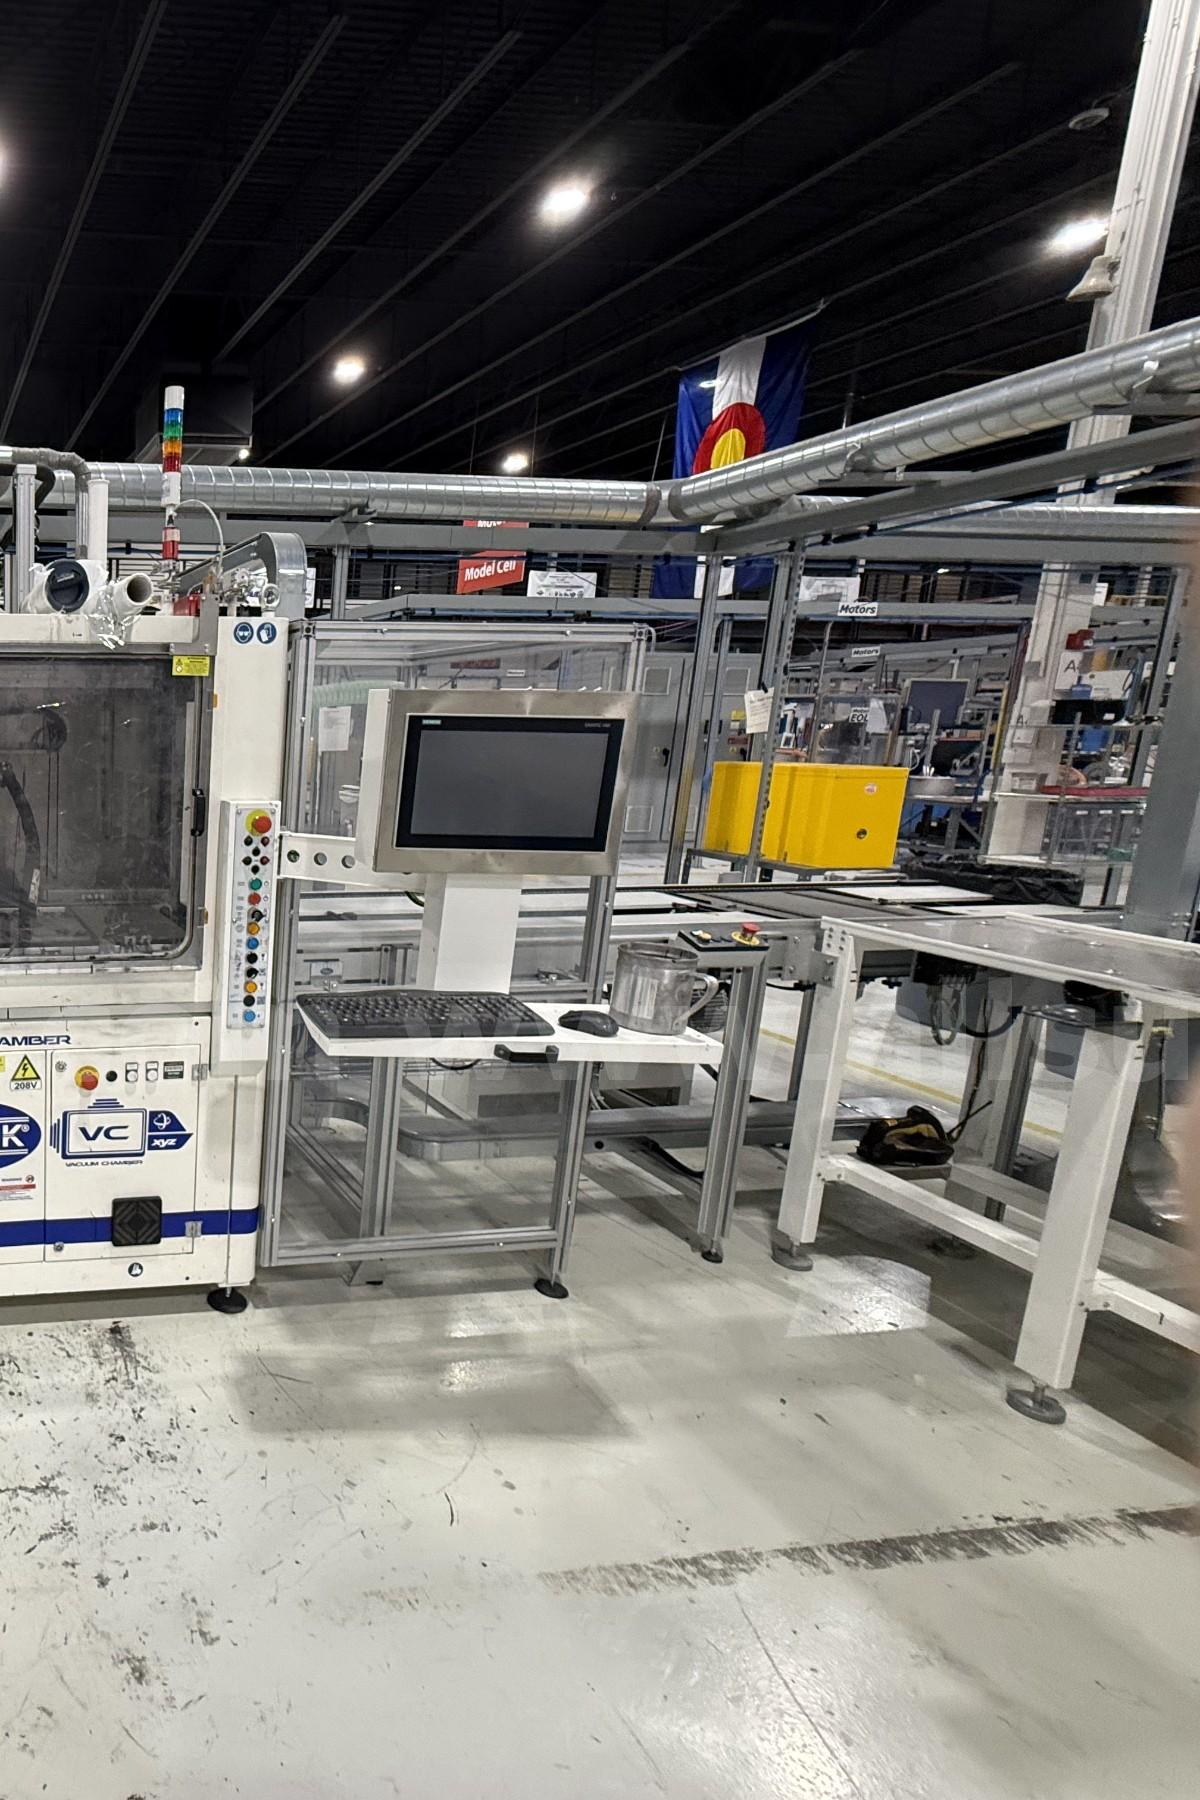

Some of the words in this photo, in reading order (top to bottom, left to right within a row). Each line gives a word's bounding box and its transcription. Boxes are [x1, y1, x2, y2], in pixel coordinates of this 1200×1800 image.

[464, 560, 496, 582] Model
[497, 560, 517, 574] Cell
[839, 604, 876, 614] Motors
[14, 1081, 38, 1090] 208V
[78, 1125, 129, 1141] VC
[151, 1138, 177, 1148] xyz
